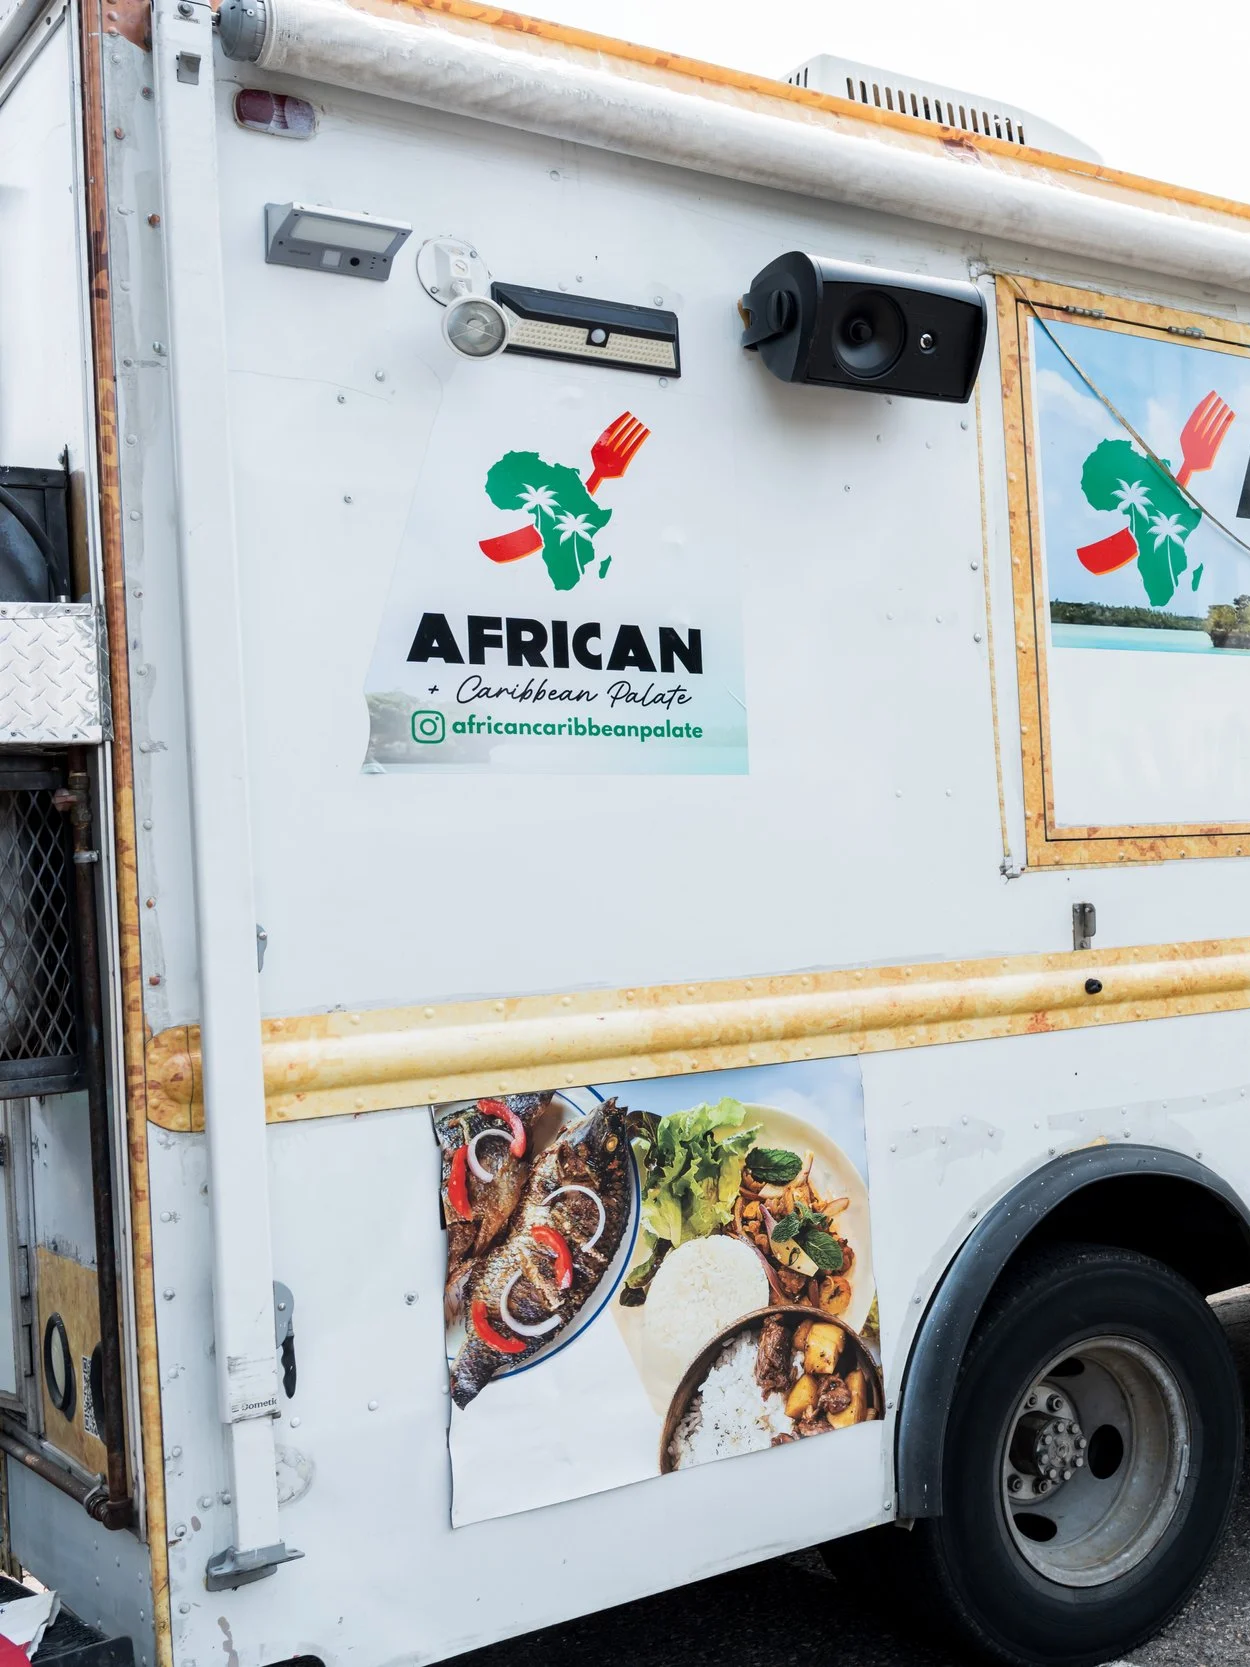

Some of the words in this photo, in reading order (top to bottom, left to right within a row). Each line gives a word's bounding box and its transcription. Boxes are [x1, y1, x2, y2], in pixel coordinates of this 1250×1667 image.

[406, 612, 704, 675] AFRICAN
[428, 685, 439, 695] +
[456, 675, 598, 704] Caribbean
[607, 680, 693, 710] Palate
[452, 715, 703, 742] africancaribbeanpalate
